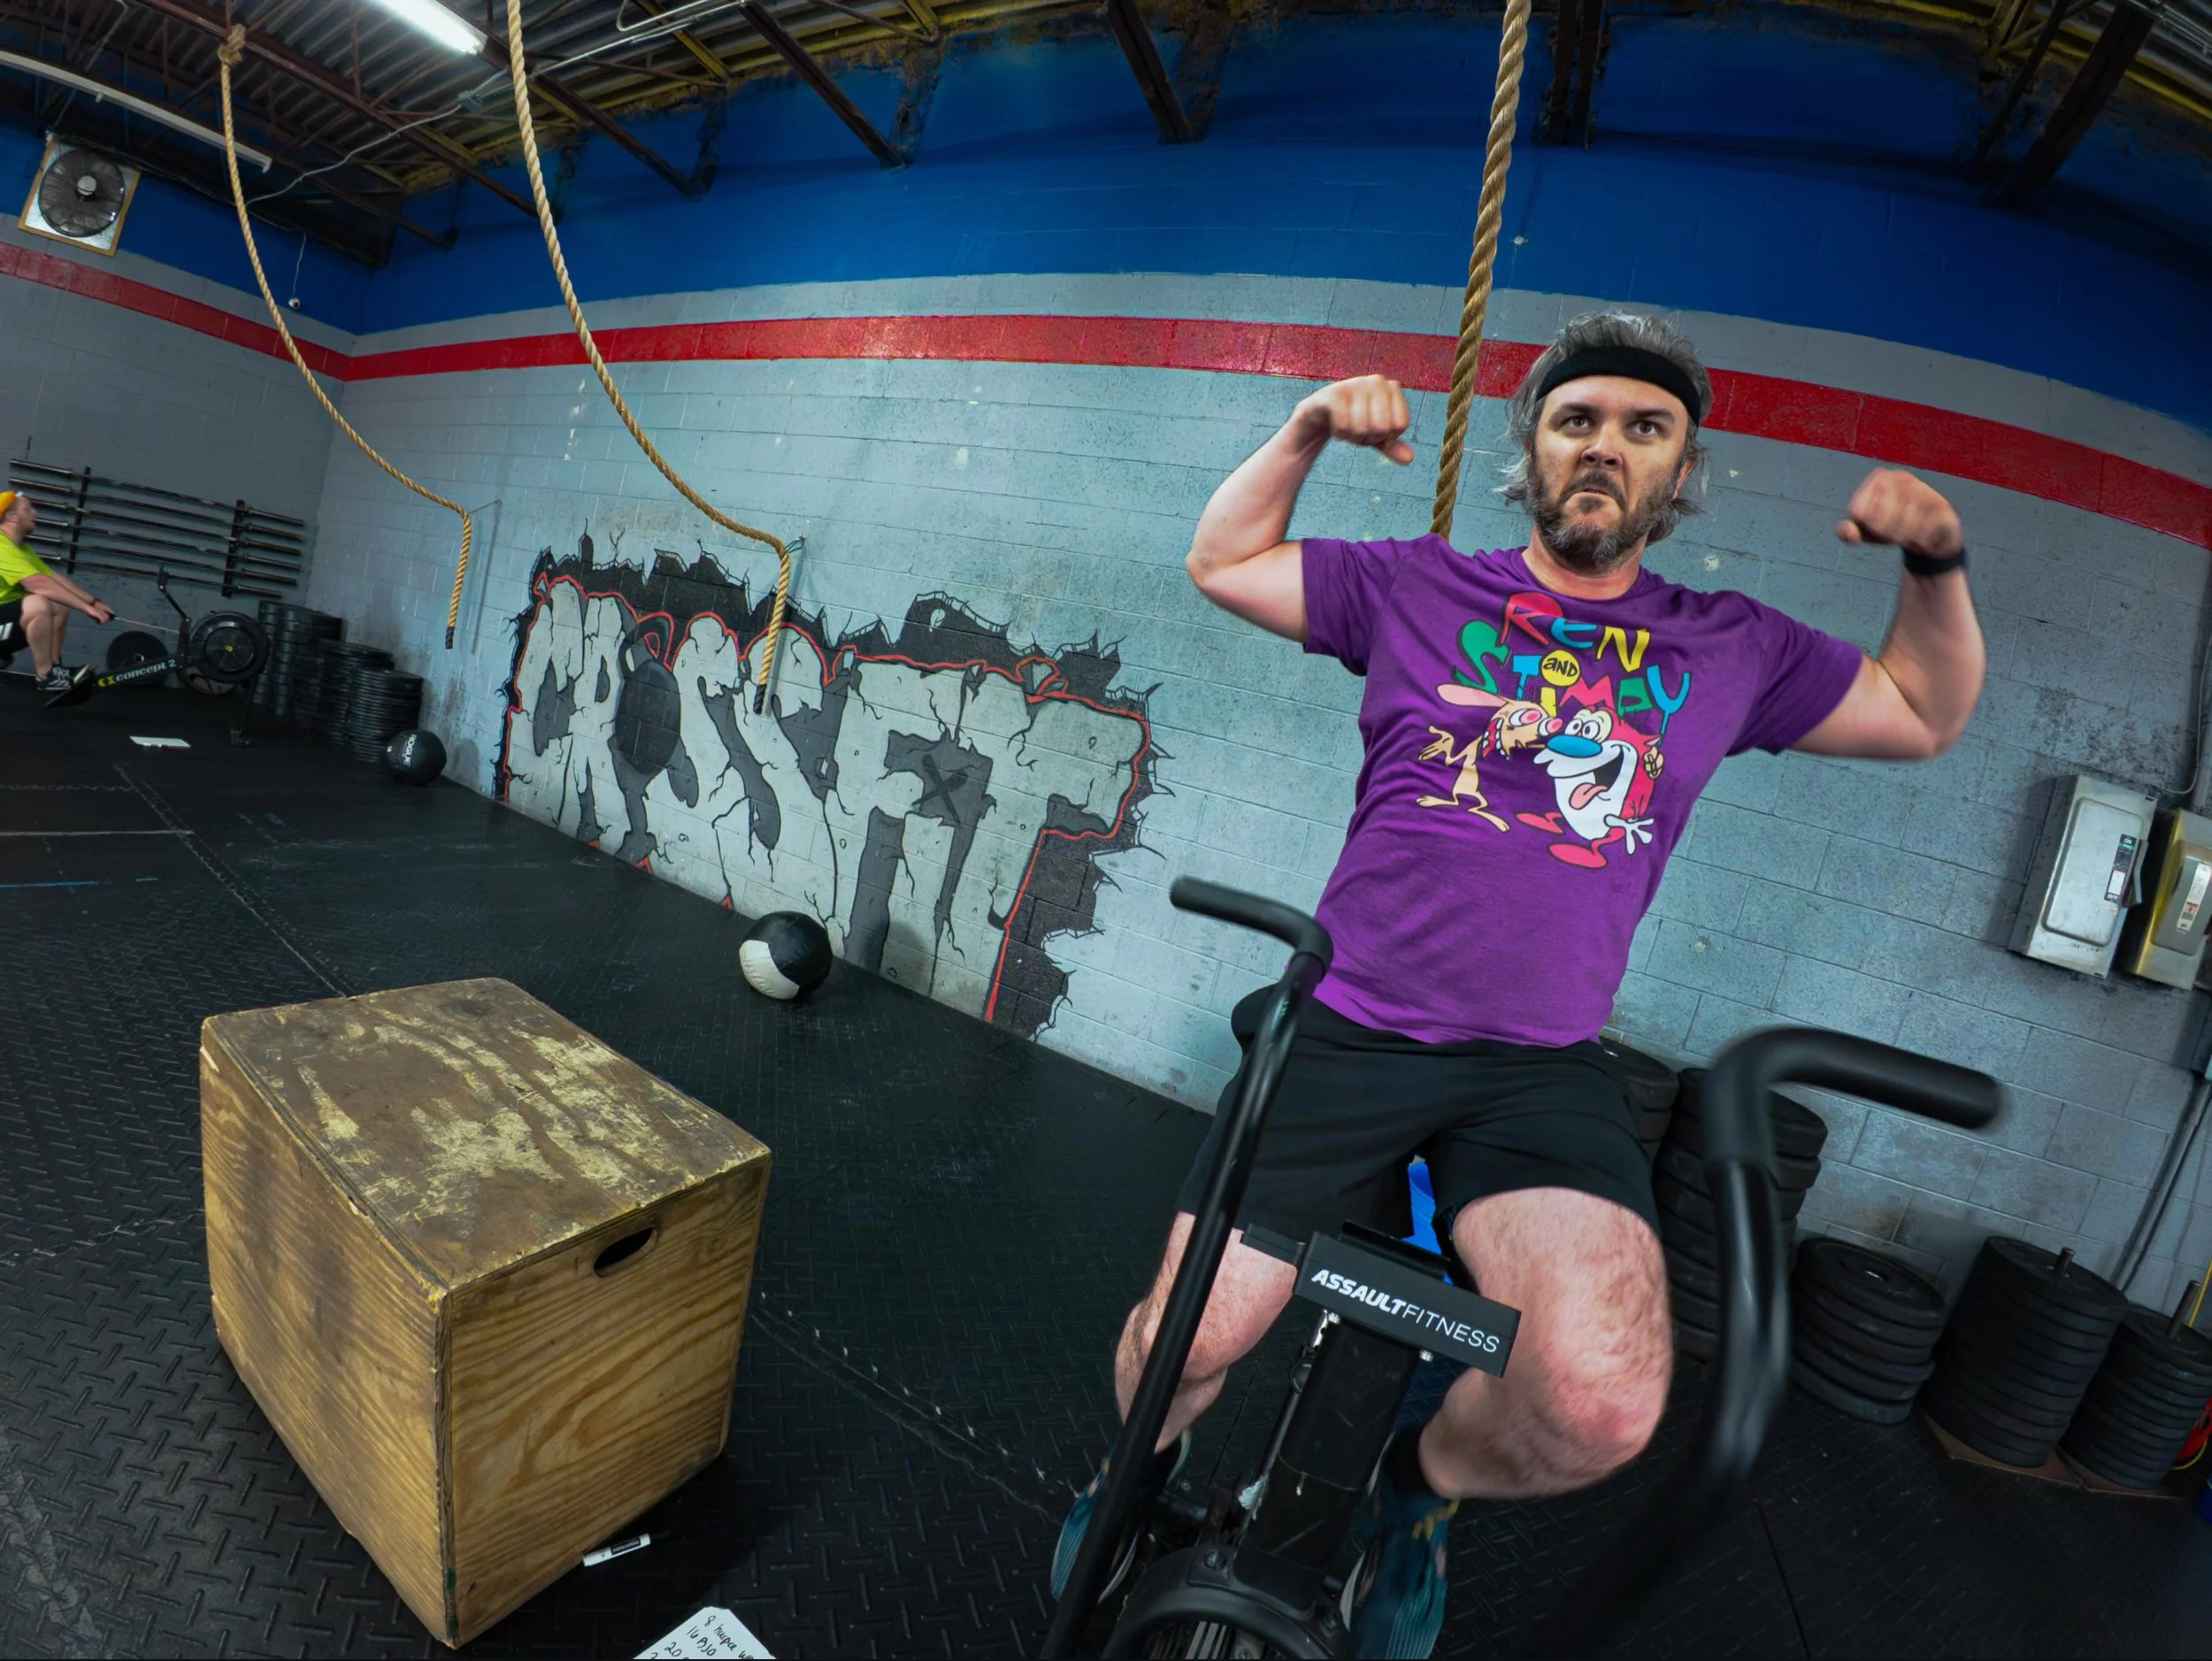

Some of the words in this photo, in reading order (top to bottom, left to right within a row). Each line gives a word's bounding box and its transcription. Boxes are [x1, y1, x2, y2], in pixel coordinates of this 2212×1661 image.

[1500, 592, 1651, 673] REN
[116, 662, 167, 681] concept
[1452, 619, 1691, 748] STIMPY
[403, 734, 417, 766] ROGUE
[704, 1615, 716, 1626] 8
[664, 1642, 682, 1657] 20
